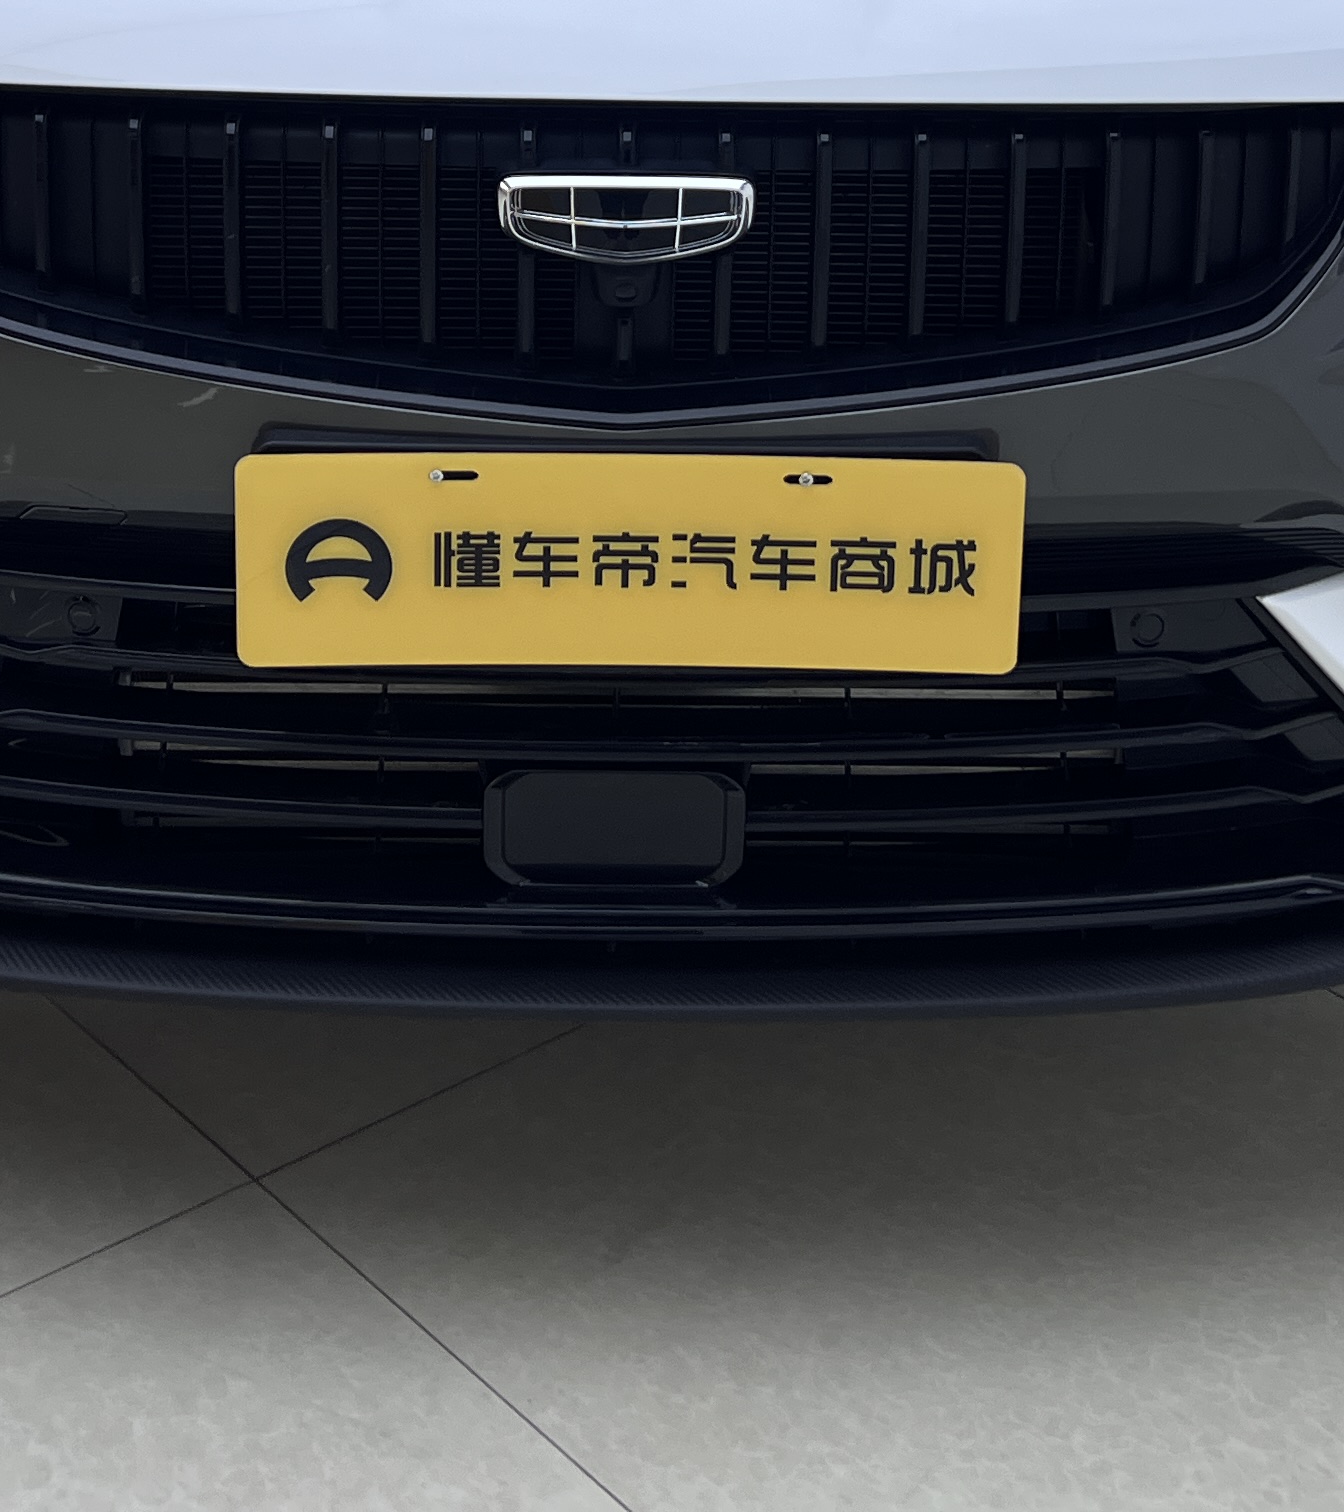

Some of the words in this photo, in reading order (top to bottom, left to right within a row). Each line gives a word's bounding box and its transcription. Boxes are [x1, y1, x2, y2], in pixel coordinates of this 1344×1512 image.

[433, 530, 977, 597] 懂车帝汽车商城
